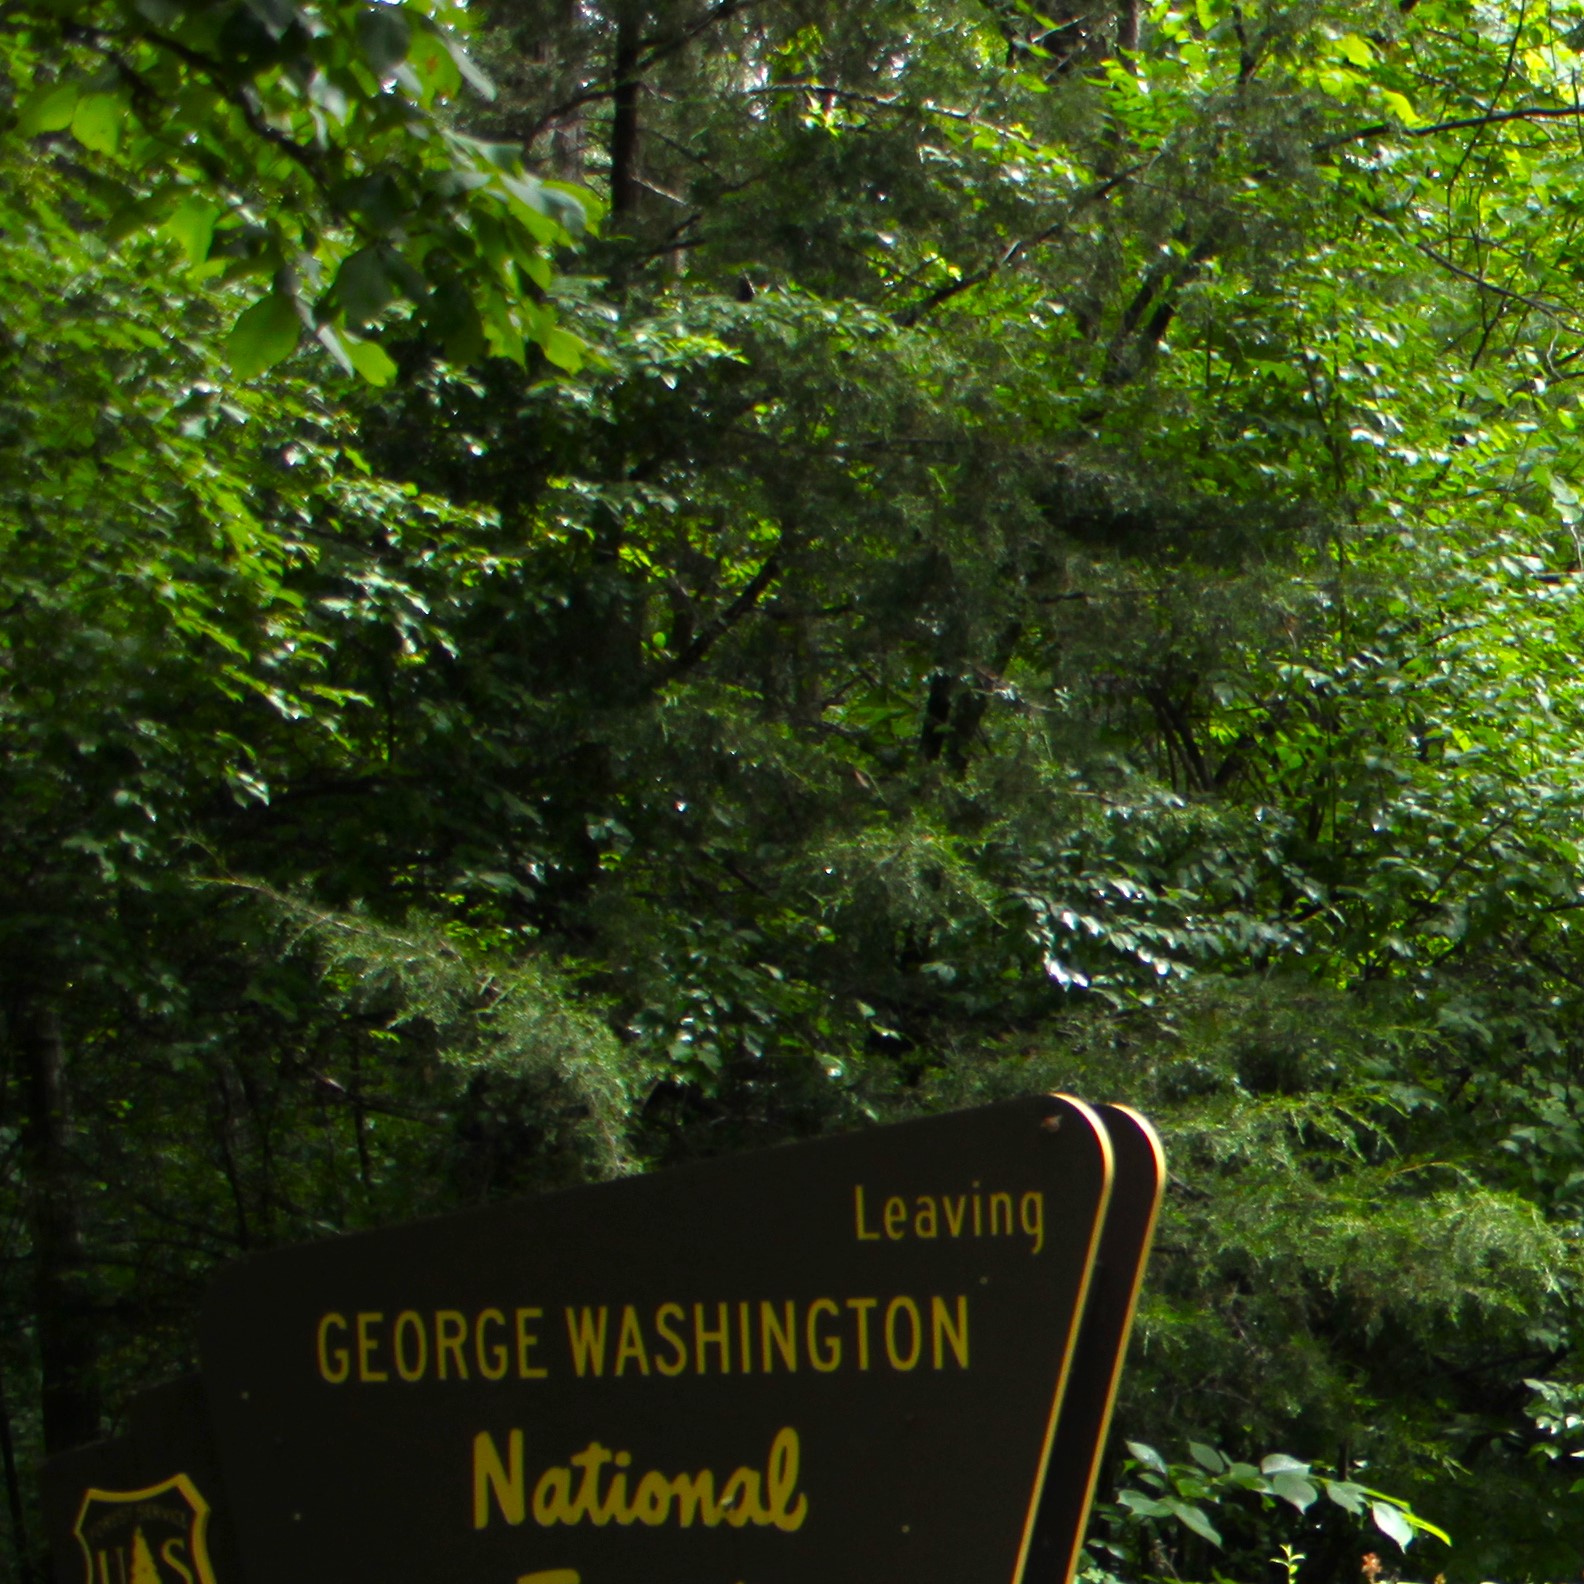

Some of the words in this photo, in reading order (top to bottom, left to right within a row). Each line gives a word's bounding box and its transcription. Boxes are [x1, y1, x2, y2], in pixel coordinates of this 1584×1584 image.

[855, 1184, 1045, 1253] Leaving
[318, 1308, 548, 1384] GEORGE
[567, 1296, 969, 1376] WASHINGTON
[474, 1427, 808, 1531] National
